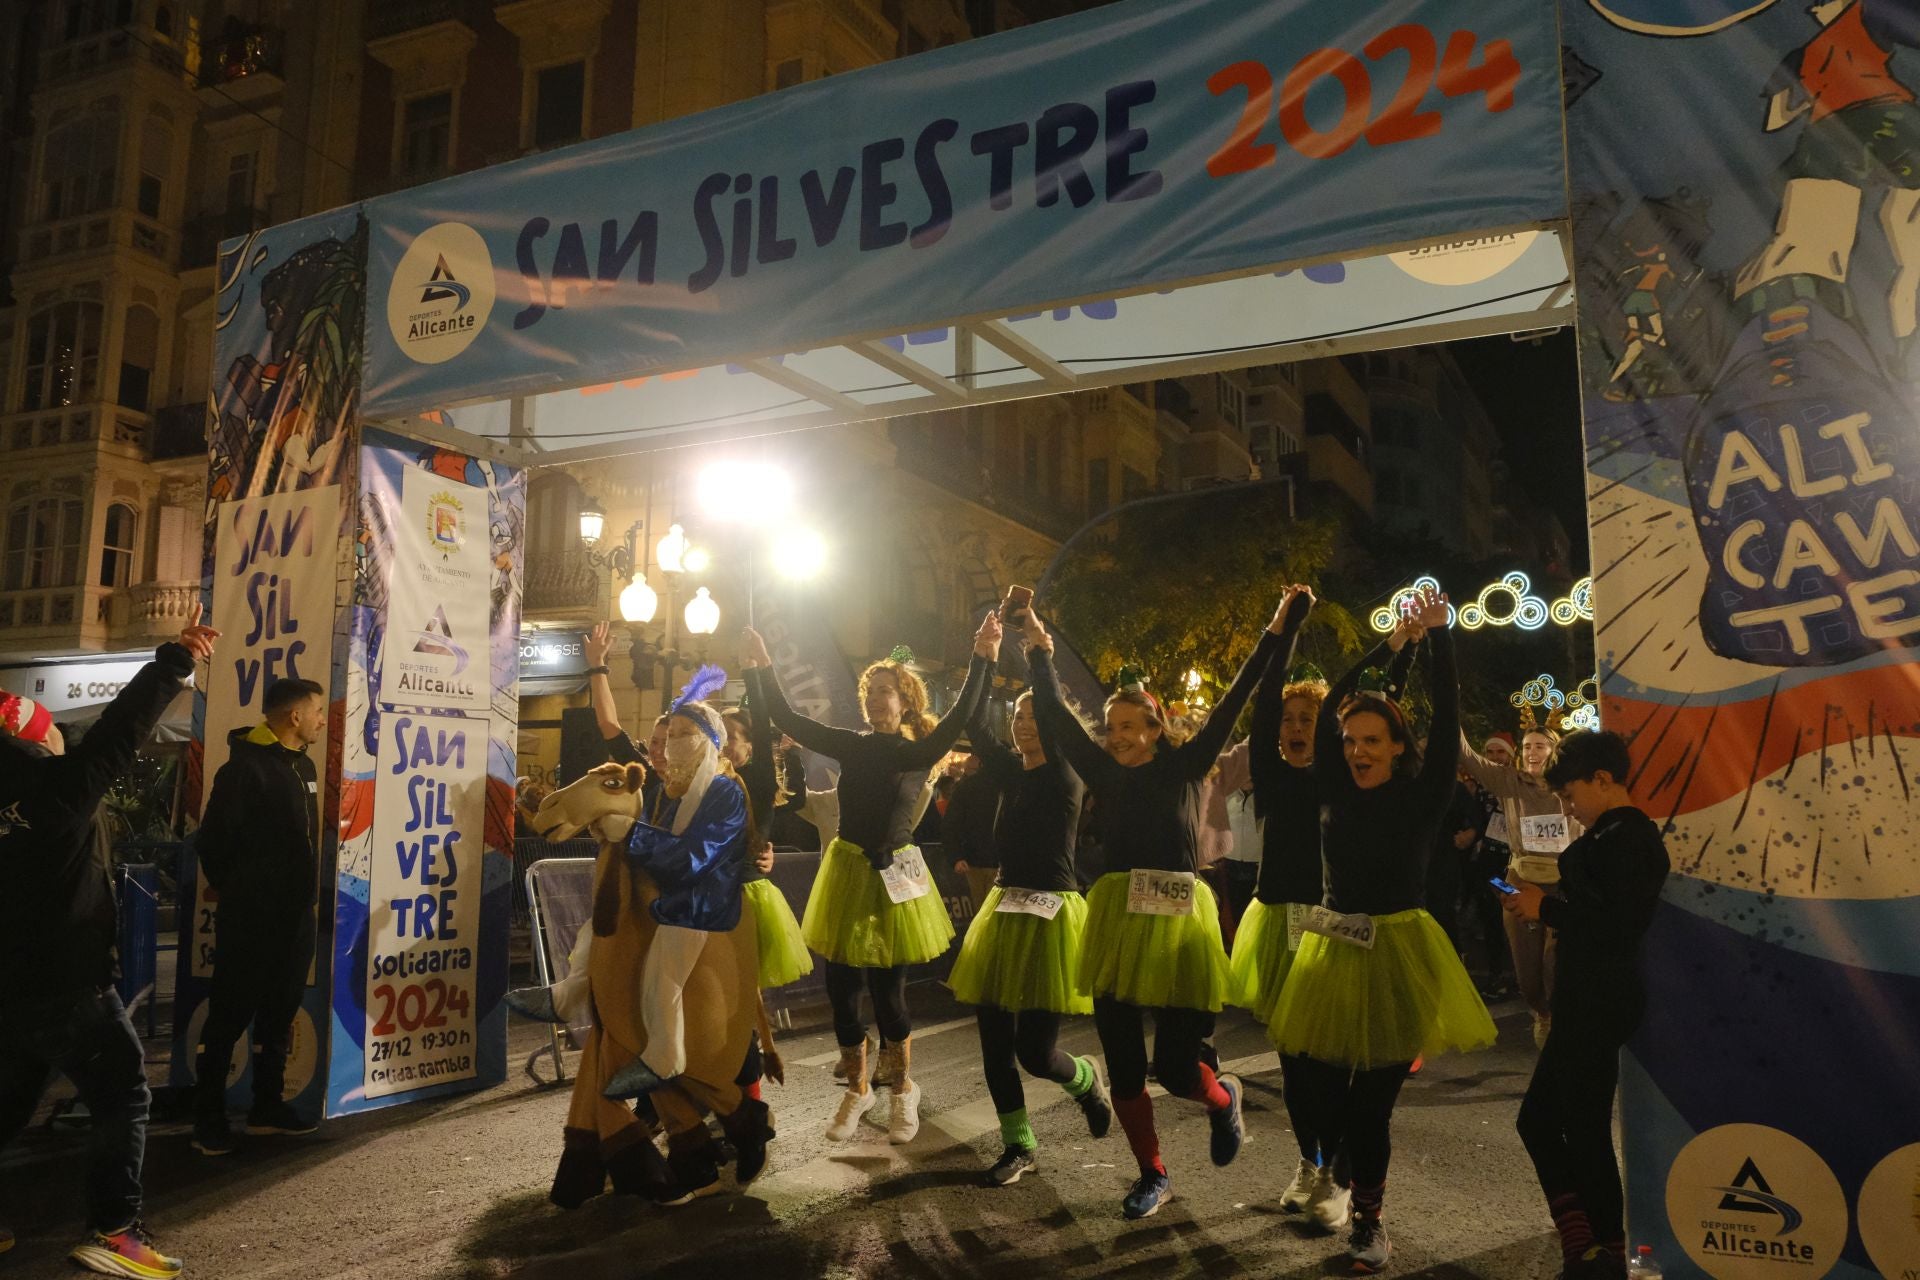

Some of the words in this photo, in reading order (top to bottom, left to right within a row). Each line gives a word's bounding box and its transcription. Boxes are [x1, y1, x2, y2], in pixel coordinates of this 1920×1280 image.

[513, 210, 658, 330] SAN
[1205, 23, 1521, 179] 2024
[408, 315, 475, 338] Alicante
[409, 311, 442, 321] DEPORTES
[1708, 412, 1894, 510] ALI
[231, 503, 313, 576] SAN
[1722, 497, 1920, 590] CAN
[417, 563, 471, 579] AYTAMIENTO
[1729, 569, 1920, 655] TE
[400, 662, 439, 674] DEPORTES
[67, 682, 82, 698] 26
[398, 672, 474, 695] Alicante
[392, 717, 466, 775] SAN
[1537, 823, 1564, 838] 2124
[395, 831, 461, 888] VES
[1023, 895, 1056, 909] 1453
[1152, 881, 1189, 900] 1455
[390, 890, 458, 941] TRE
[372, 979, 469, 1036] 2024
[371, 1037, 411, 1062] 27/12
[1701, 1220, 1757, 1233] DEPORTES
[1702, 1231, 1814, 1259] Alicante
